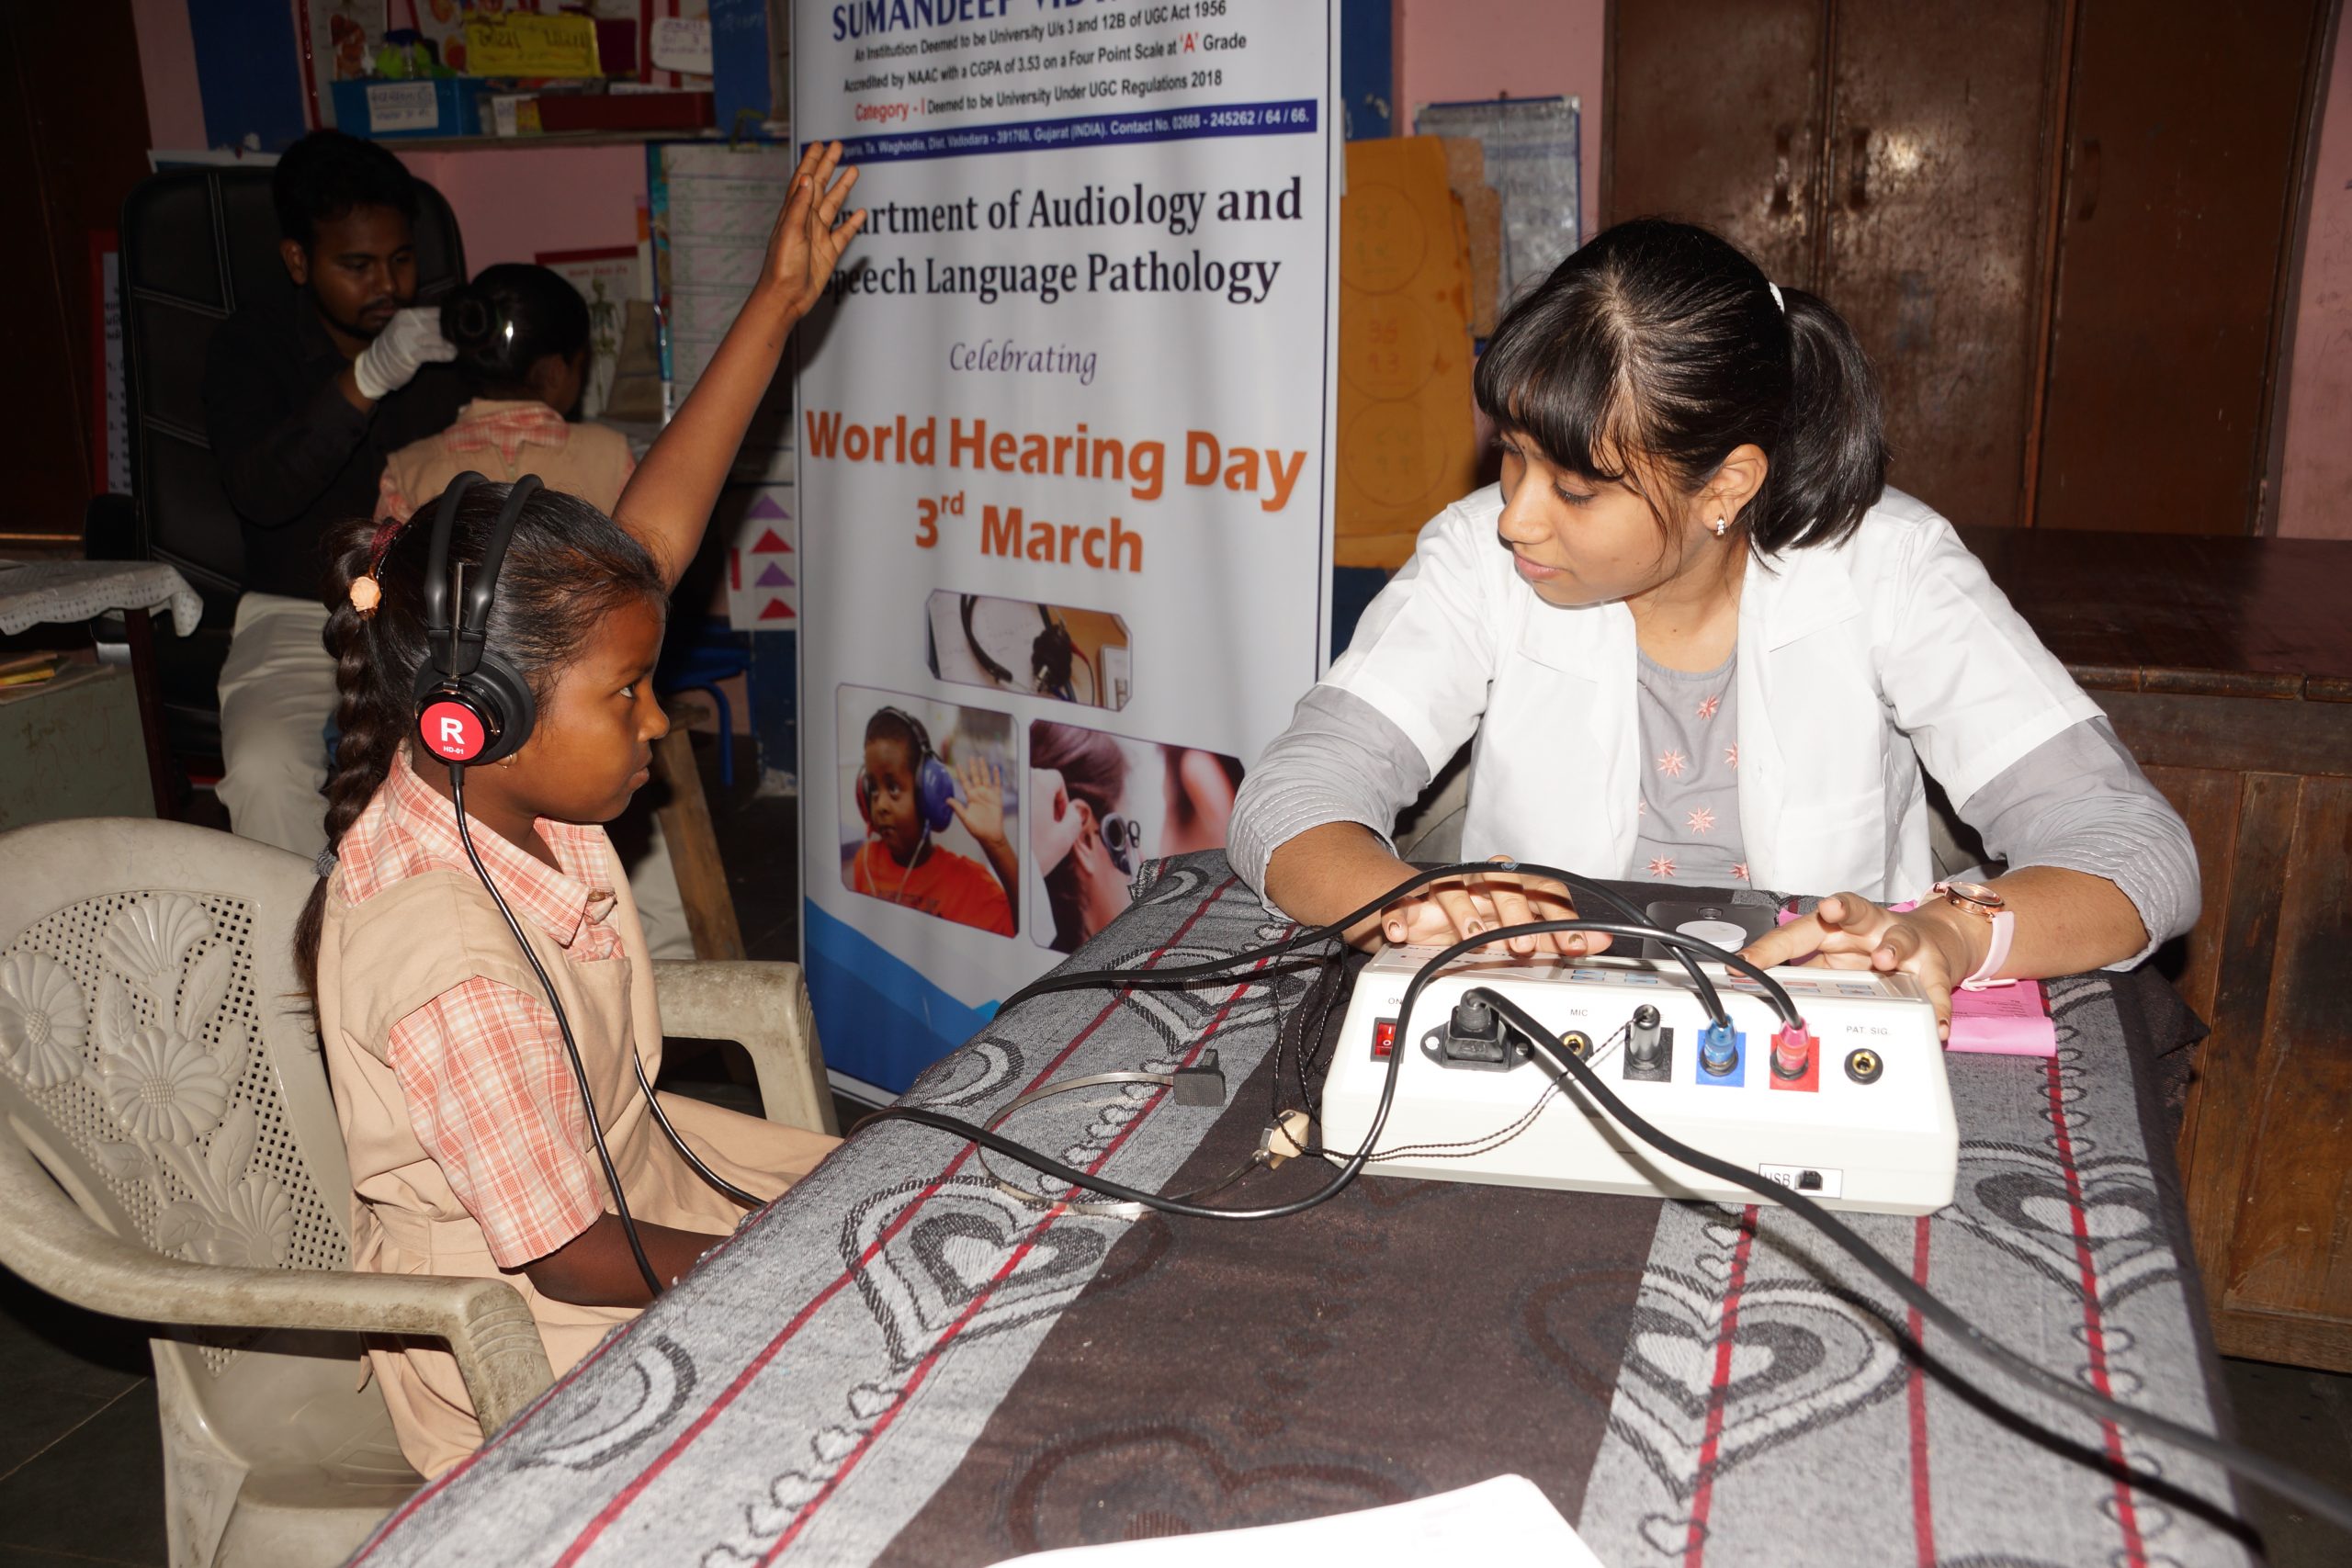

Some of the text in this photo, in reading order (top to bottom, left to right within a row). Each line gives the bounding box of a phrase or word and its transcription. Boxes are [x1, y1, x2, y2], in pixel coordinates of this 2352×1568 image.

[854, 49, 865, 62] An
[866, 40, 918, 60] Institution
[921, 35, 958, 54] Deemed
[960, 35, 970, 49] to
[974, 31, 987, 47] be
[989, 24, 1045, 45] University
[1068, 18, 1075, 35] 3
[1077, 16, 1098, 33] and
[1102, 12, 1125, 30] 12B
[1129, 10, 1142, 28] of
[1144, 6, 1169, 26] UGC
[1170, 5, 1191, 22] Act
[1194, 0, 1227, 17] 1956
[843, 73, 889, 92] Accredited
[891, 72, 905, 90] by
[908, 67, 938, 85] NAAC
[940, 64, 959, 81] with
[961, 66, 967, 79] a
[969, 60, 1001, 77] CGPA
[1004, 57, 1016, 74] of
[1017, 54, 1041, 73] 3.53
[1043, 56, 1058, 71] on
[1060, 54, 1068, 68] a
[1069, 49, 1094, 67] Four
[1098, 44, 1131, 64] Point
[1135, 41, 1164, 61] Scale
[1167, 39, 1177, 56] at
[1203, 32, 1247, 51] Grade
[855, 102, 910, 123] Category
[927, 96, 964, 115] Deemed
[967, 96, 978, 109] to
[980, 93, 993, 108] be
[997, 87, 1052, 107] University
[1054, 84, 1086, 102] Under
[1089, 80, 1117, 98] UGC
[1122, 75, 1188, 98] Regulations
[1191, 69, 1223, 88] 2018
[1034, 125, 1069, 144] Gujarat
[1110, 118, 1153, 135] Contact
[1155, 118, 1170, 132] No.
[1210, 109, 1255, 128] 245262
[1265, 108, 1281, 125] 64
[1291, 107, 1310, 123] 66.
[987, 188, 1022, 231] of
[1027, 183, 1207, 235] Audiology
[1216, 175, 1303, 221] and
[926, 257, 1077, 305] Language
[1088, 249, 1282, 304] Pathology
[950, 338, 1098, 386] Celebrating
[806, 410, 936, 467] World
[949, 418, 1165, 502] Hearing
[1185, 429, 1307, 513] Day
[915, 490, 1144, 573] 3rd March
[441, 716, 465, 745] R
[443, 746, 464, 755] HD-01
[1570, 1009, 1589, 1017] MIC
